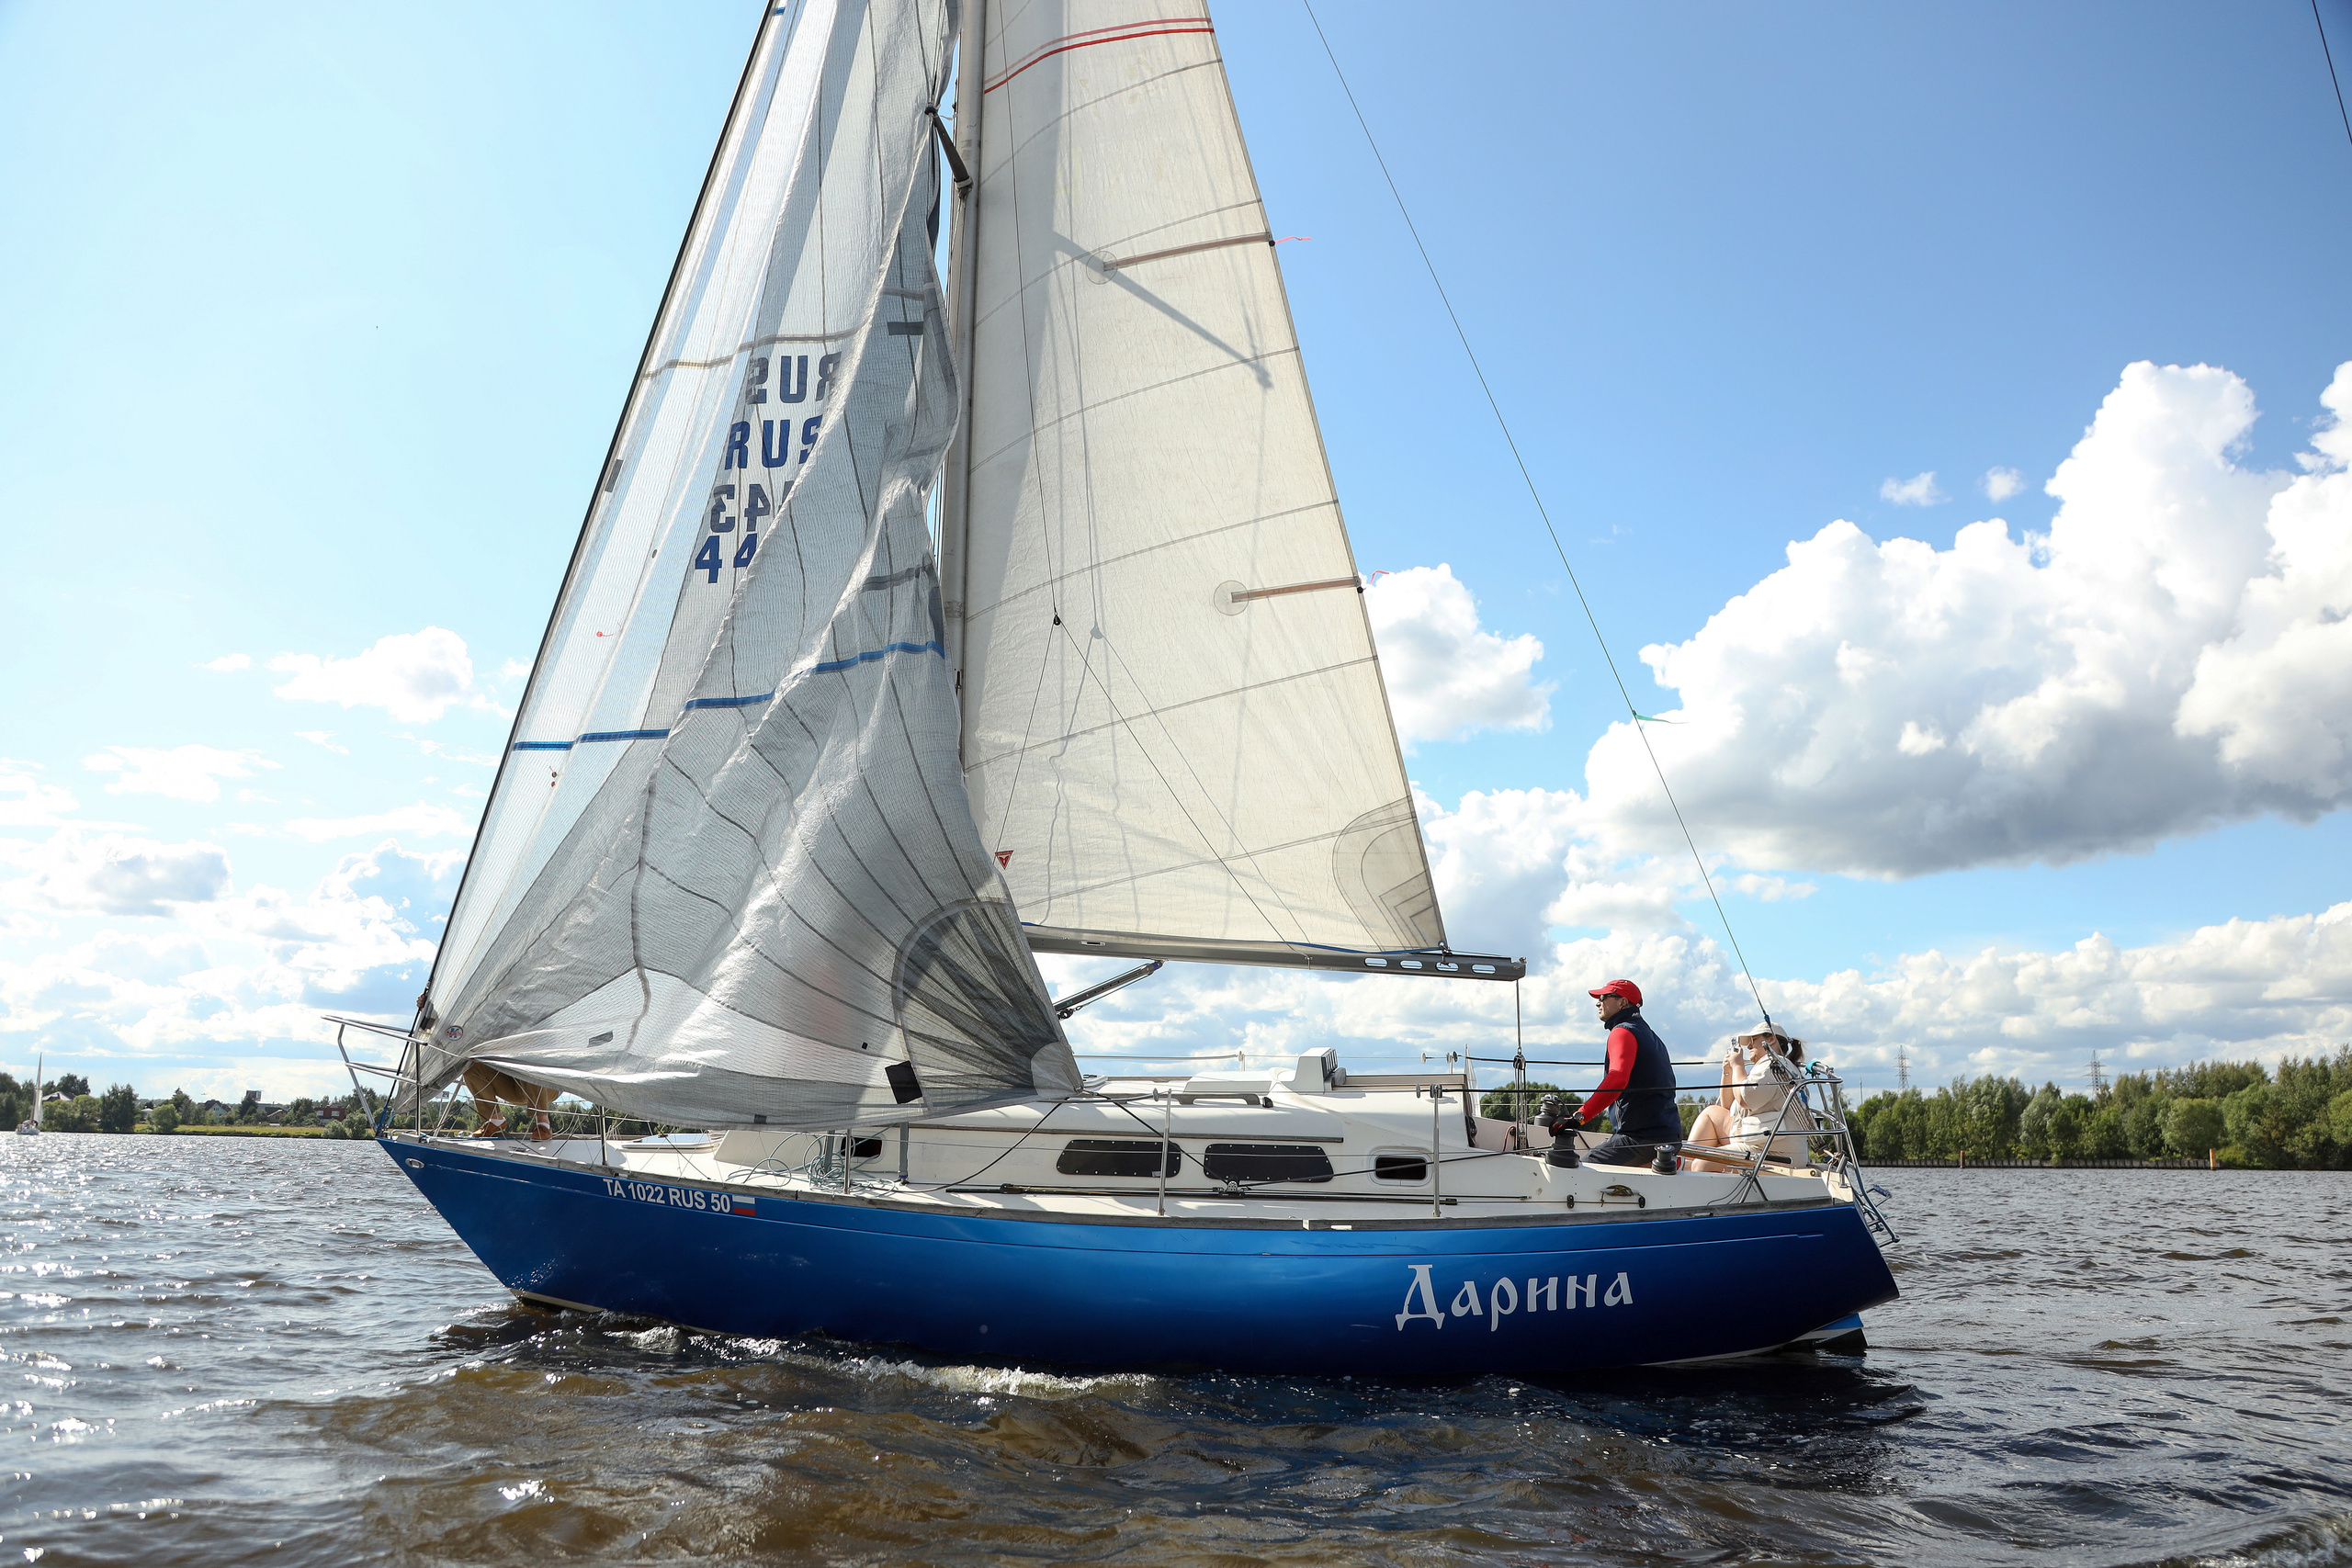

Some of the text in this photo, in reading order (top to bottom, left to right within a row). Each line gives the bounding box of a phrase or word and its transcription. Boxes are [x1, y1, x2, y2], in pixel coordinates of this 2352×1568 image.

[724, 414, 823, 470] RUS
[628, 1182, 665, 1204] 1022
[669, 1188, 707, 1210] RUS
[711, 1194, 730, 1213] 50
[1395, 1264, 1634, 1332] Дарина
